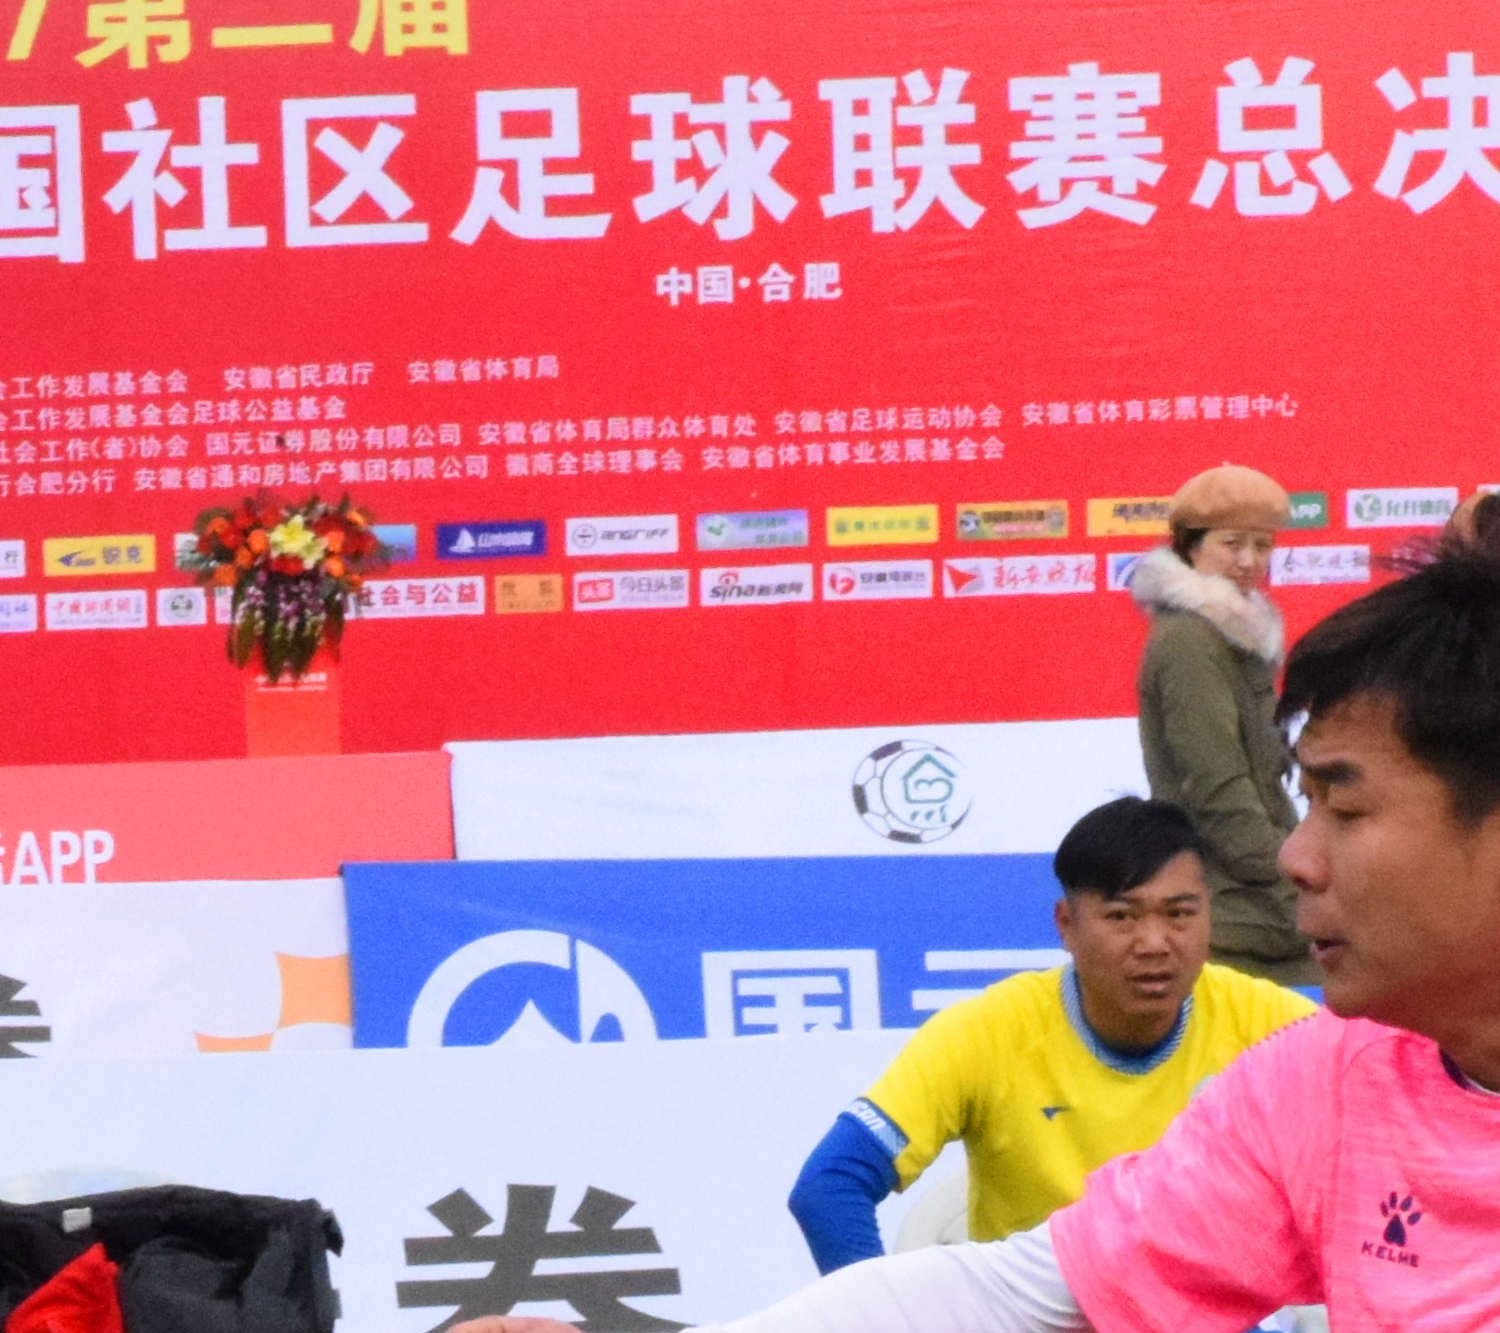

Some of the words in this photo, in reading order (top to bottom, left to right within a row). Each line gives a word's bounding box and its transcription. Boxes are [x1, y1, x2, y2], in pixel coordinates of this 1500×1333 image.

[655, 262, 842, 309] 中国·合肥
[223, 362, 374, 391] 安徽省民政厅
[407, 354, 560, 384] 安徽省体育局
[206, 423, 461, 456] 国元证券股份有限公司
[478, 414, 757, 447] 安徽省体育局群众体育处
[774, 404, 1003, 435] 安徽省足球运动协会
[1022, 393, 1298, 427] 安徽省体育彩票管理中心
[702, 436, 1005, 471] 安徽省体育事业发展基金会
